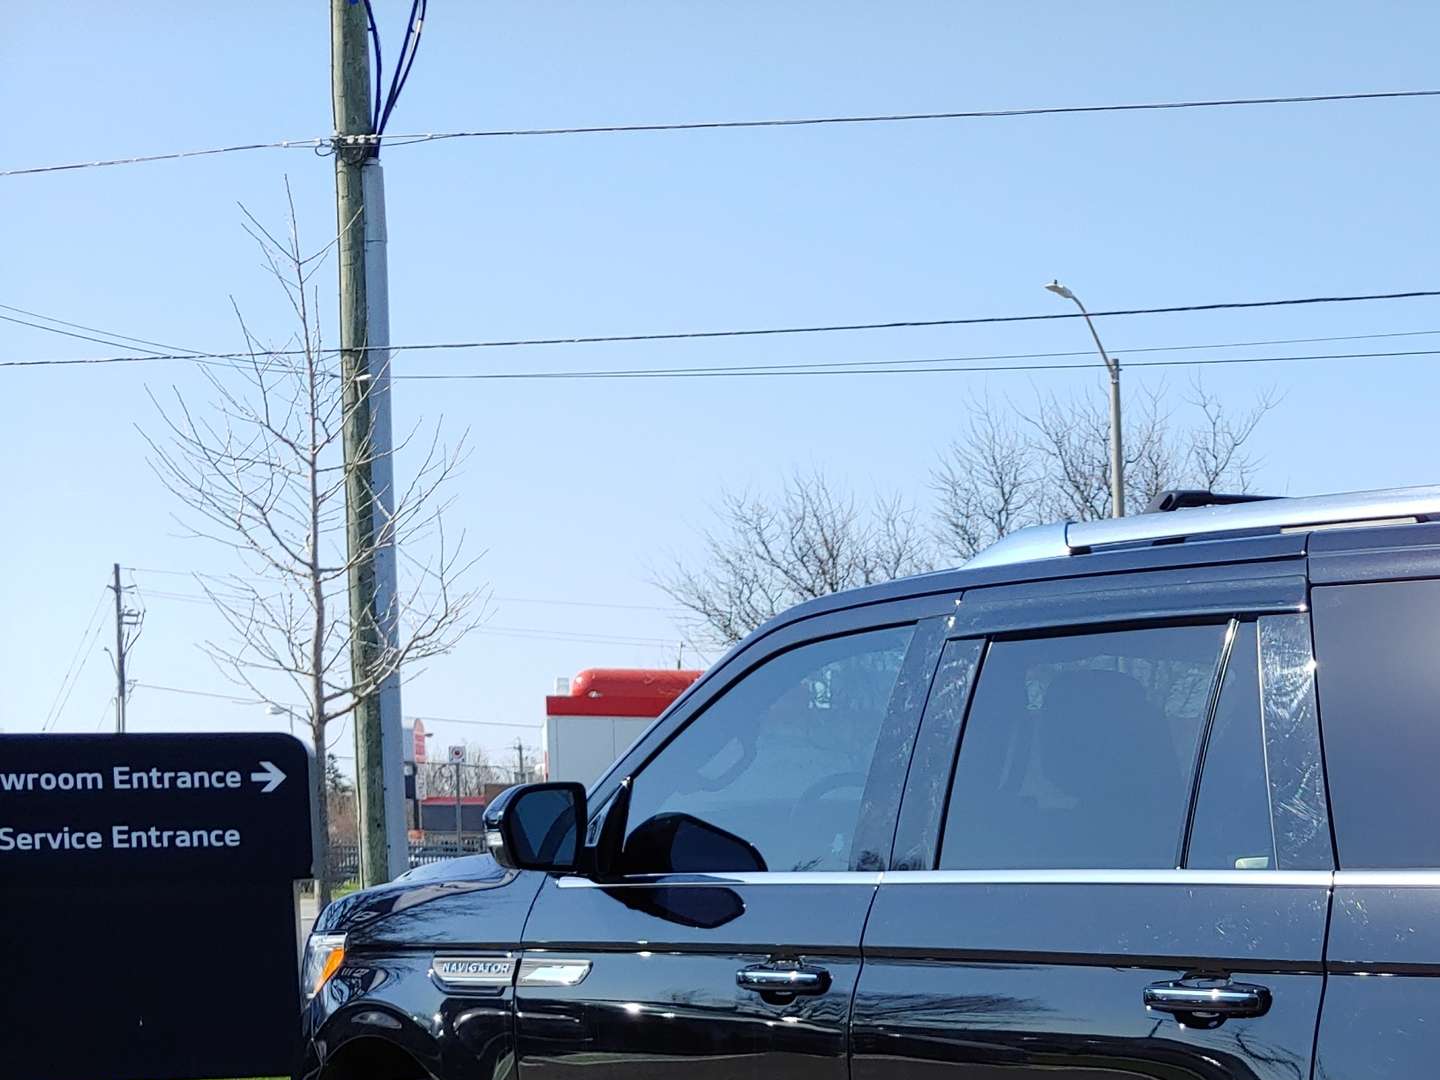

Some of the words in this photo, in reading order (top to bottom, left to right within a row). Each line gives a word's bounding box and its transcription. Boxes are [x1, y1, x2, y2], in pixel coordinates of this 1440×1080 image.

[113, 767, 242, 789] Entrance
[0, 826, 103, 850] Service
[112, 825, 241, 849] Entrance
[442, 962, 510, 974] NAVIGATOR
